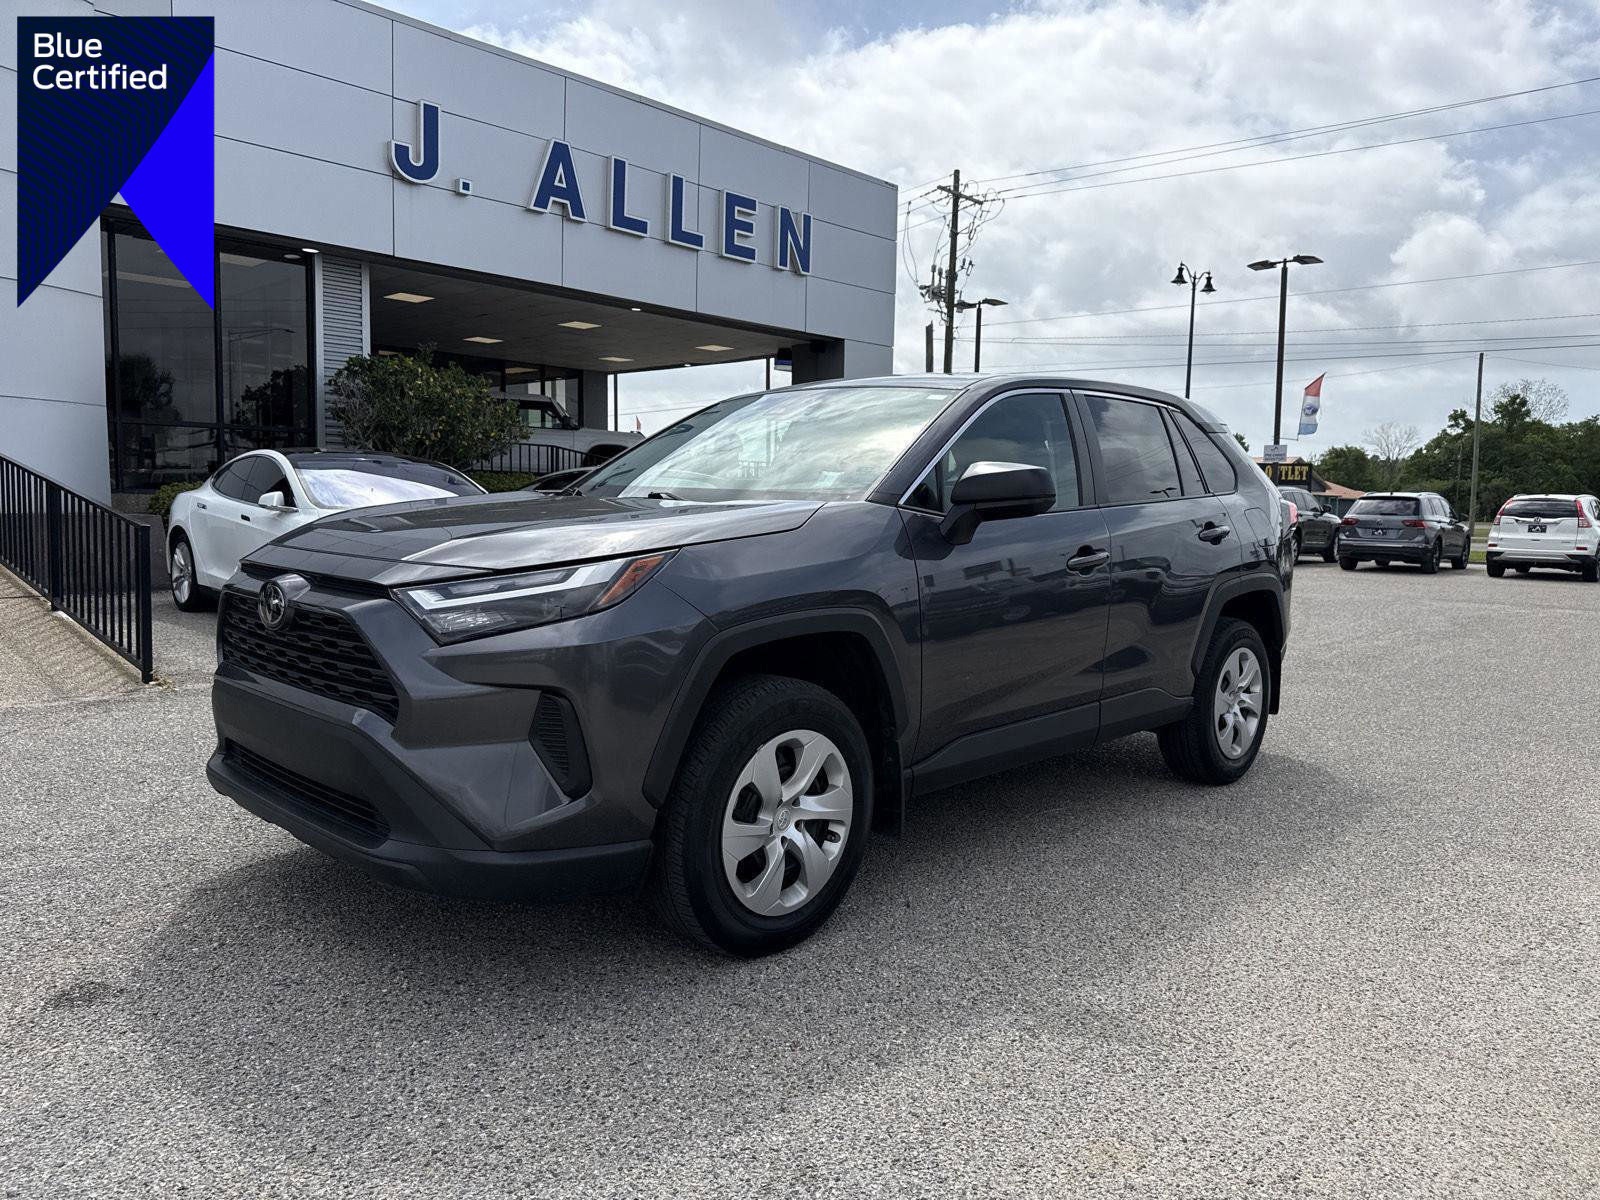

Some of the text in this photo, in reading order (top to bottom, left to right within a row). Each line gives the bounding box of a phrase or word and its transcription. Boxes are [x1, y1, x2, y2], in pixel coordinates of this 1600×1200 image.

[388, 99, 813, 275] J. ALLEN
[1265, 465, 1309, 480] OTLET
